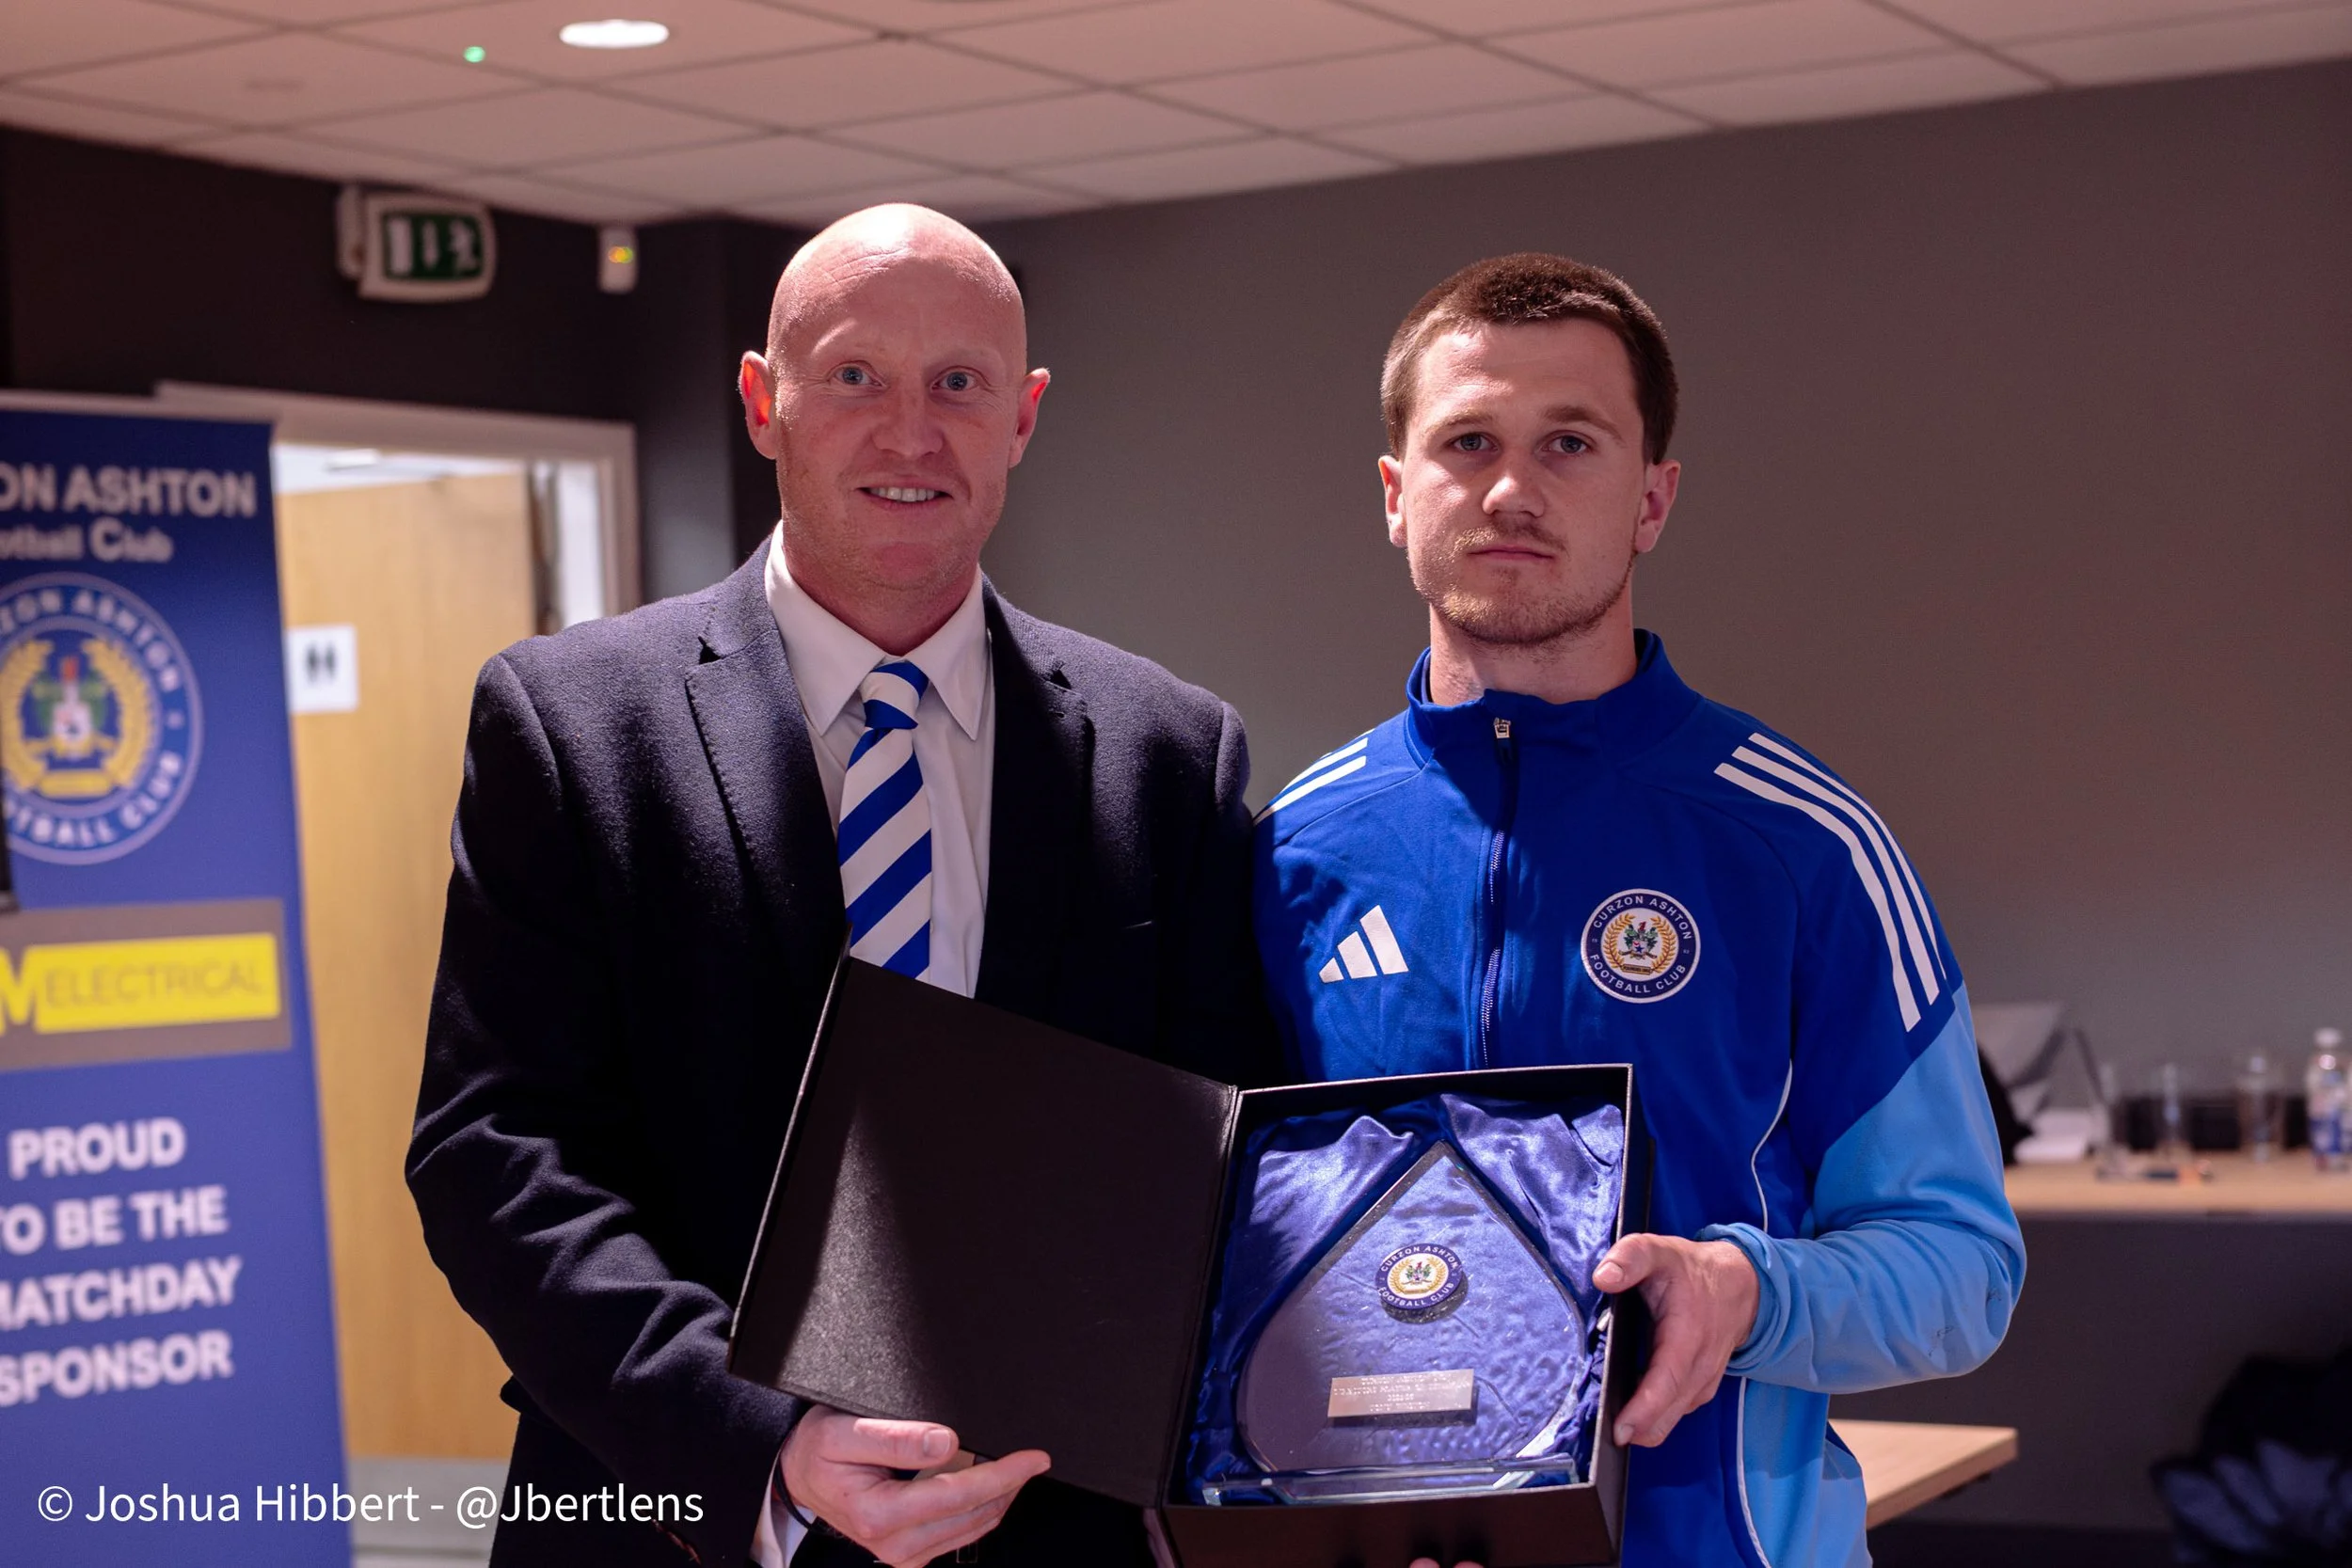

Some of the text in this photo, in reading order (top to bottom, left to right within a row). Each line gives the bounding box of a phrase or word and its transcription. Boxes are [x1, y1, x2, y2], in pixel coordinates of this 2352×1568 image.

[63, 465, 257, 517] ASHTON
[89, 517, 174, 562] Club
[72, 590, 180, 692] ASHTON
[119, 753, 182, 830] CLUB
[1593, 895, 1692, 940] CURZON ASHTON
[44, 958, 263, 1009] ELECTRICAL
[1590, 954, 1686, 993] FOOTBALL CLUB
[8, 1117, 186, 1180] PROUD
[0, 1183, 229, 1255] O BE THE
[1380, 1245, 1459, 1272] CURZON ASHTON
[1377, 1282, 1454, 1307] FOOTBALL CLUB
[0, 1329, 234, 1407] SPONSOR
